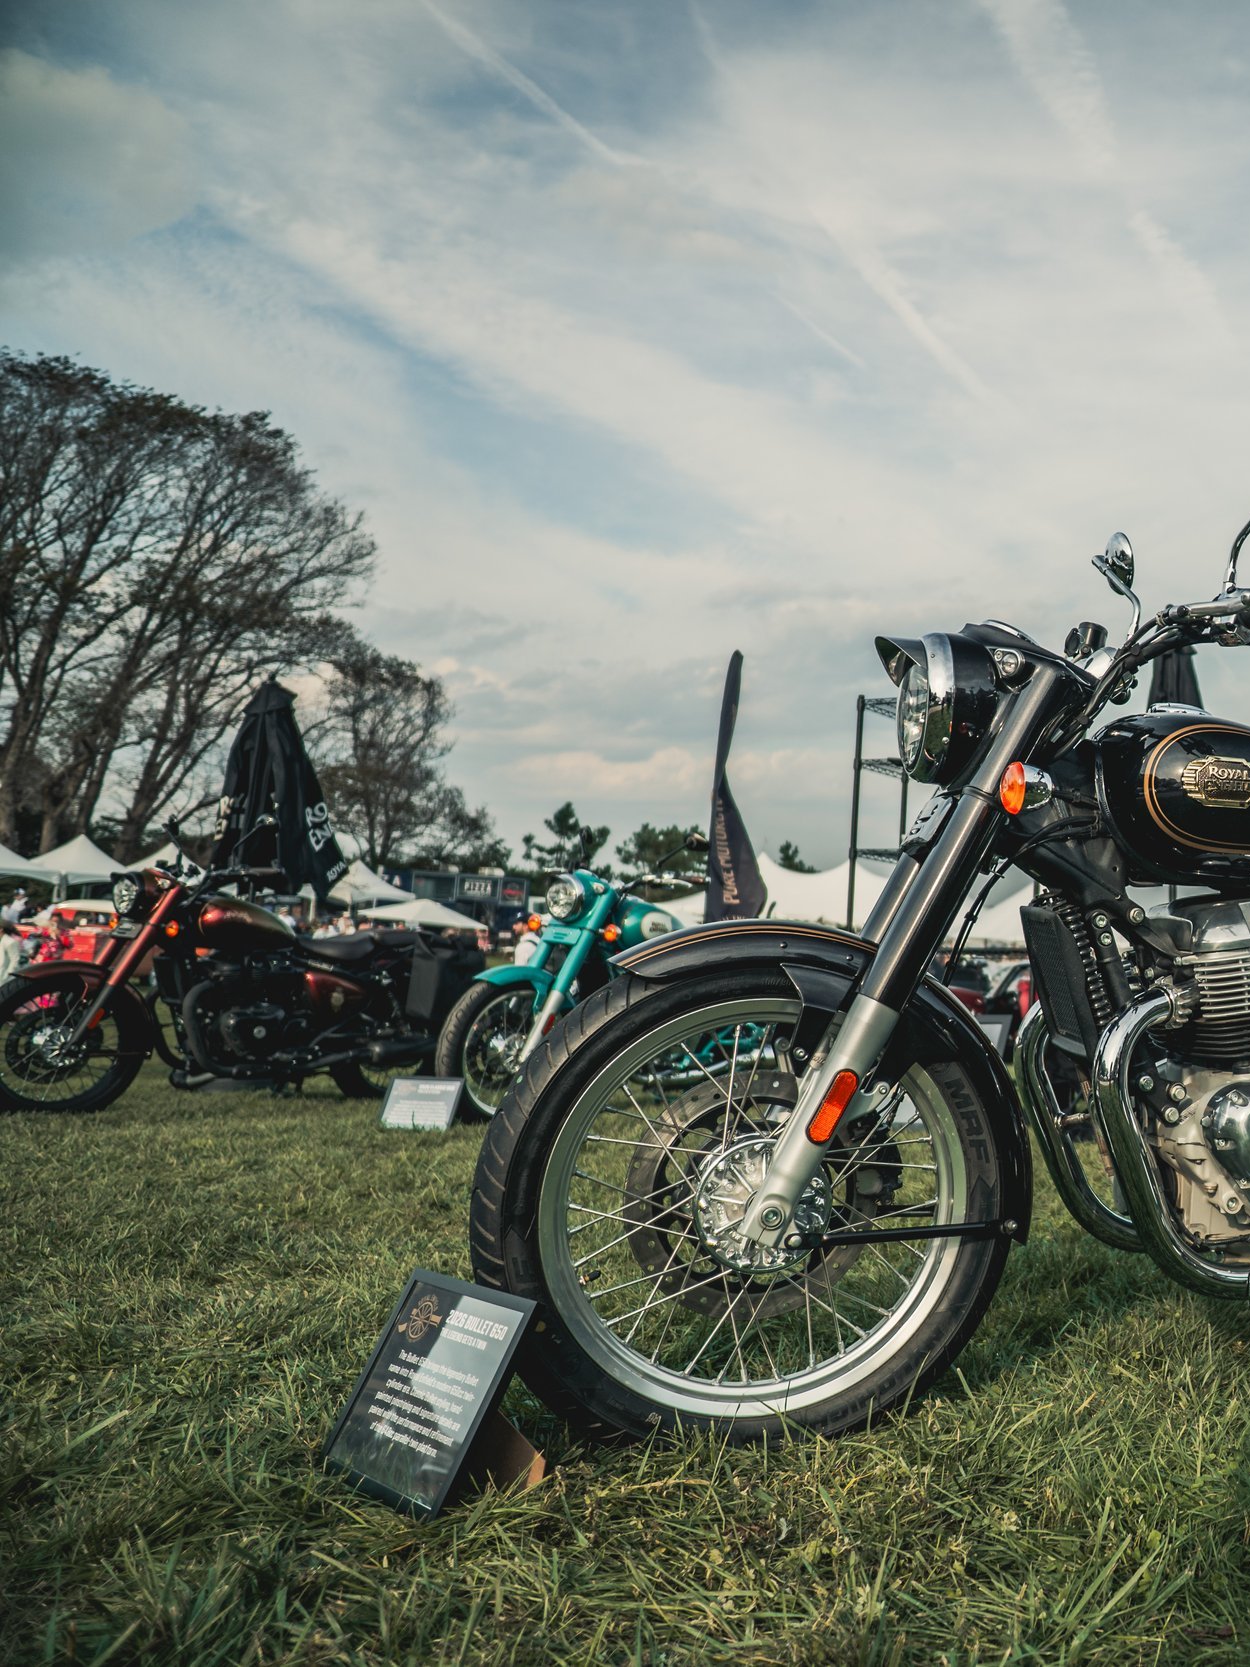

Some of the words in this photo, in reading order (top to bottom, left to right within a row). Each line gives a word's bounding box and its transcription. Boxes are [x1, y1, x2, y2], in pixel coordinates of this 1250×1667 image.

[1208, 766, 1250, 779] ROYAL
[943, 1078, 990, 1164] MRF
[445, 1309, 468, 1327] 2026
[463, 1315, 494, 1336] BULLET
[489, 1323, 508, 1341] 650
